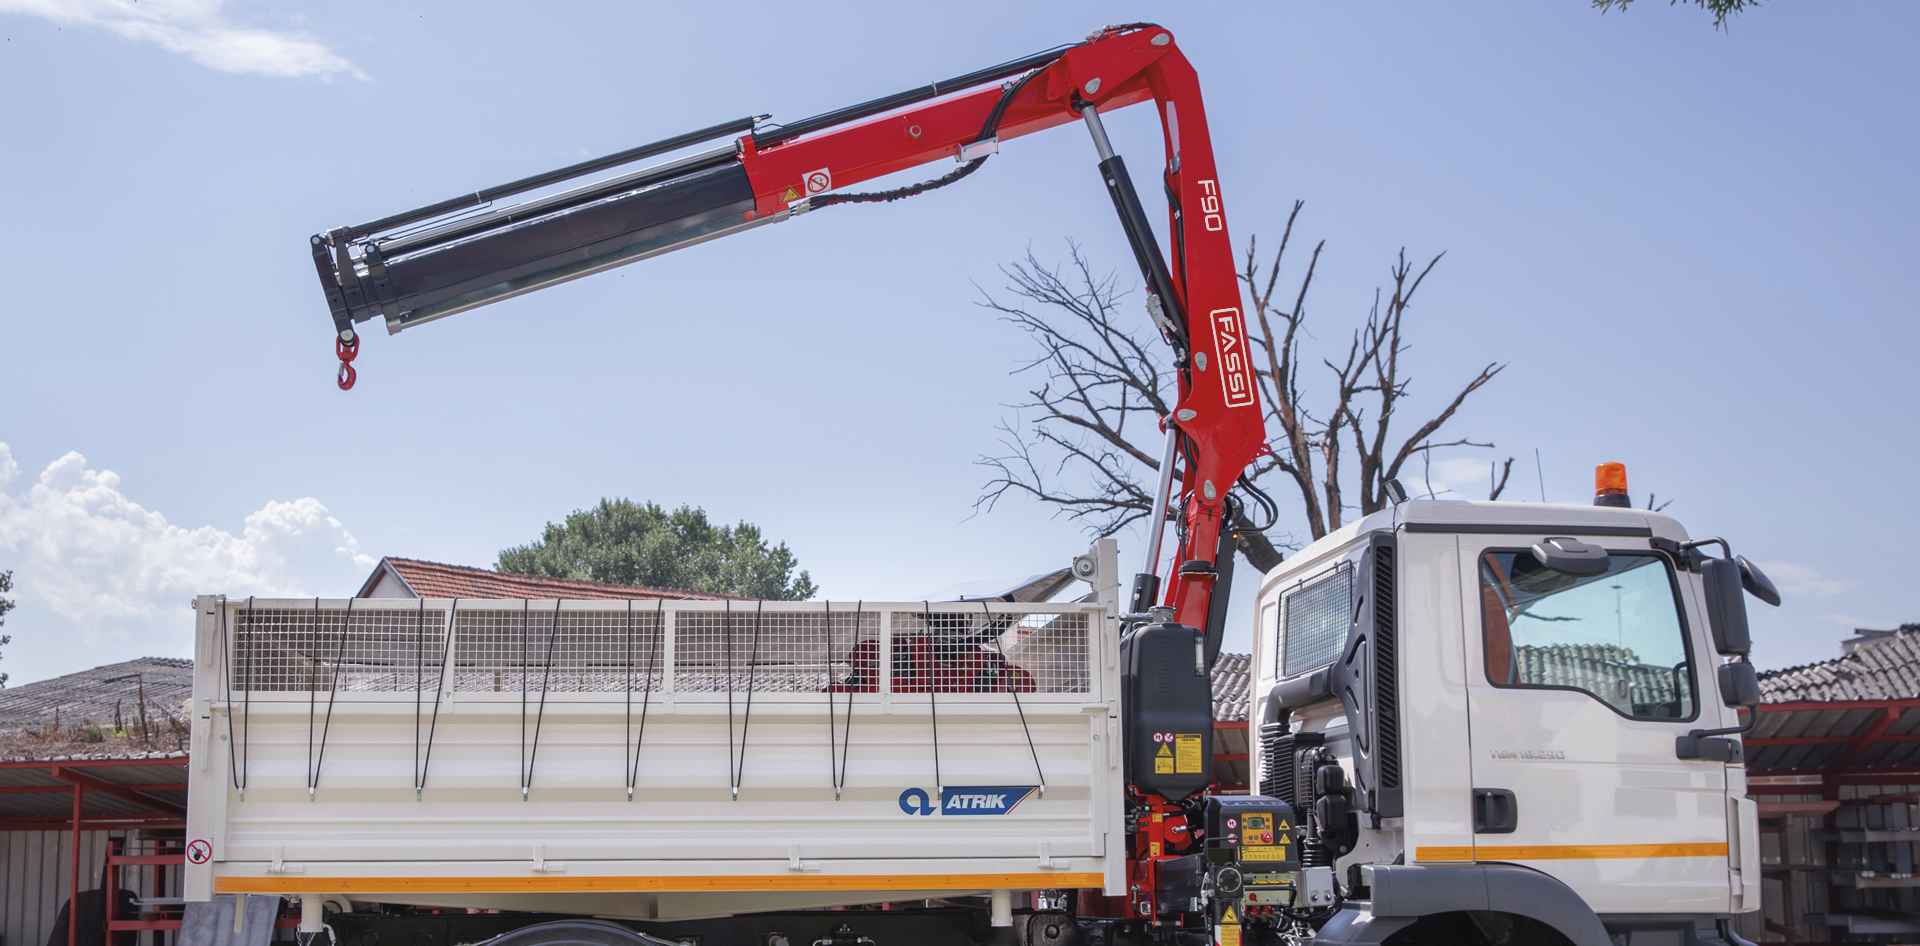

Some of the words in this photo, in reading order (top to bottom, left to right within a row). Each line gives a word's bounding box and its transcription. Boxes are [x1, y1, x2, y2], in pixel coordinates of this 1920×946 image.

[1198, 179, 1222, 232] F90
[1219, 315, 1246, 399] FASSI
[1490, 749, 1517, 759] TGM
[946, 794, 1007, 809] ATRIK
